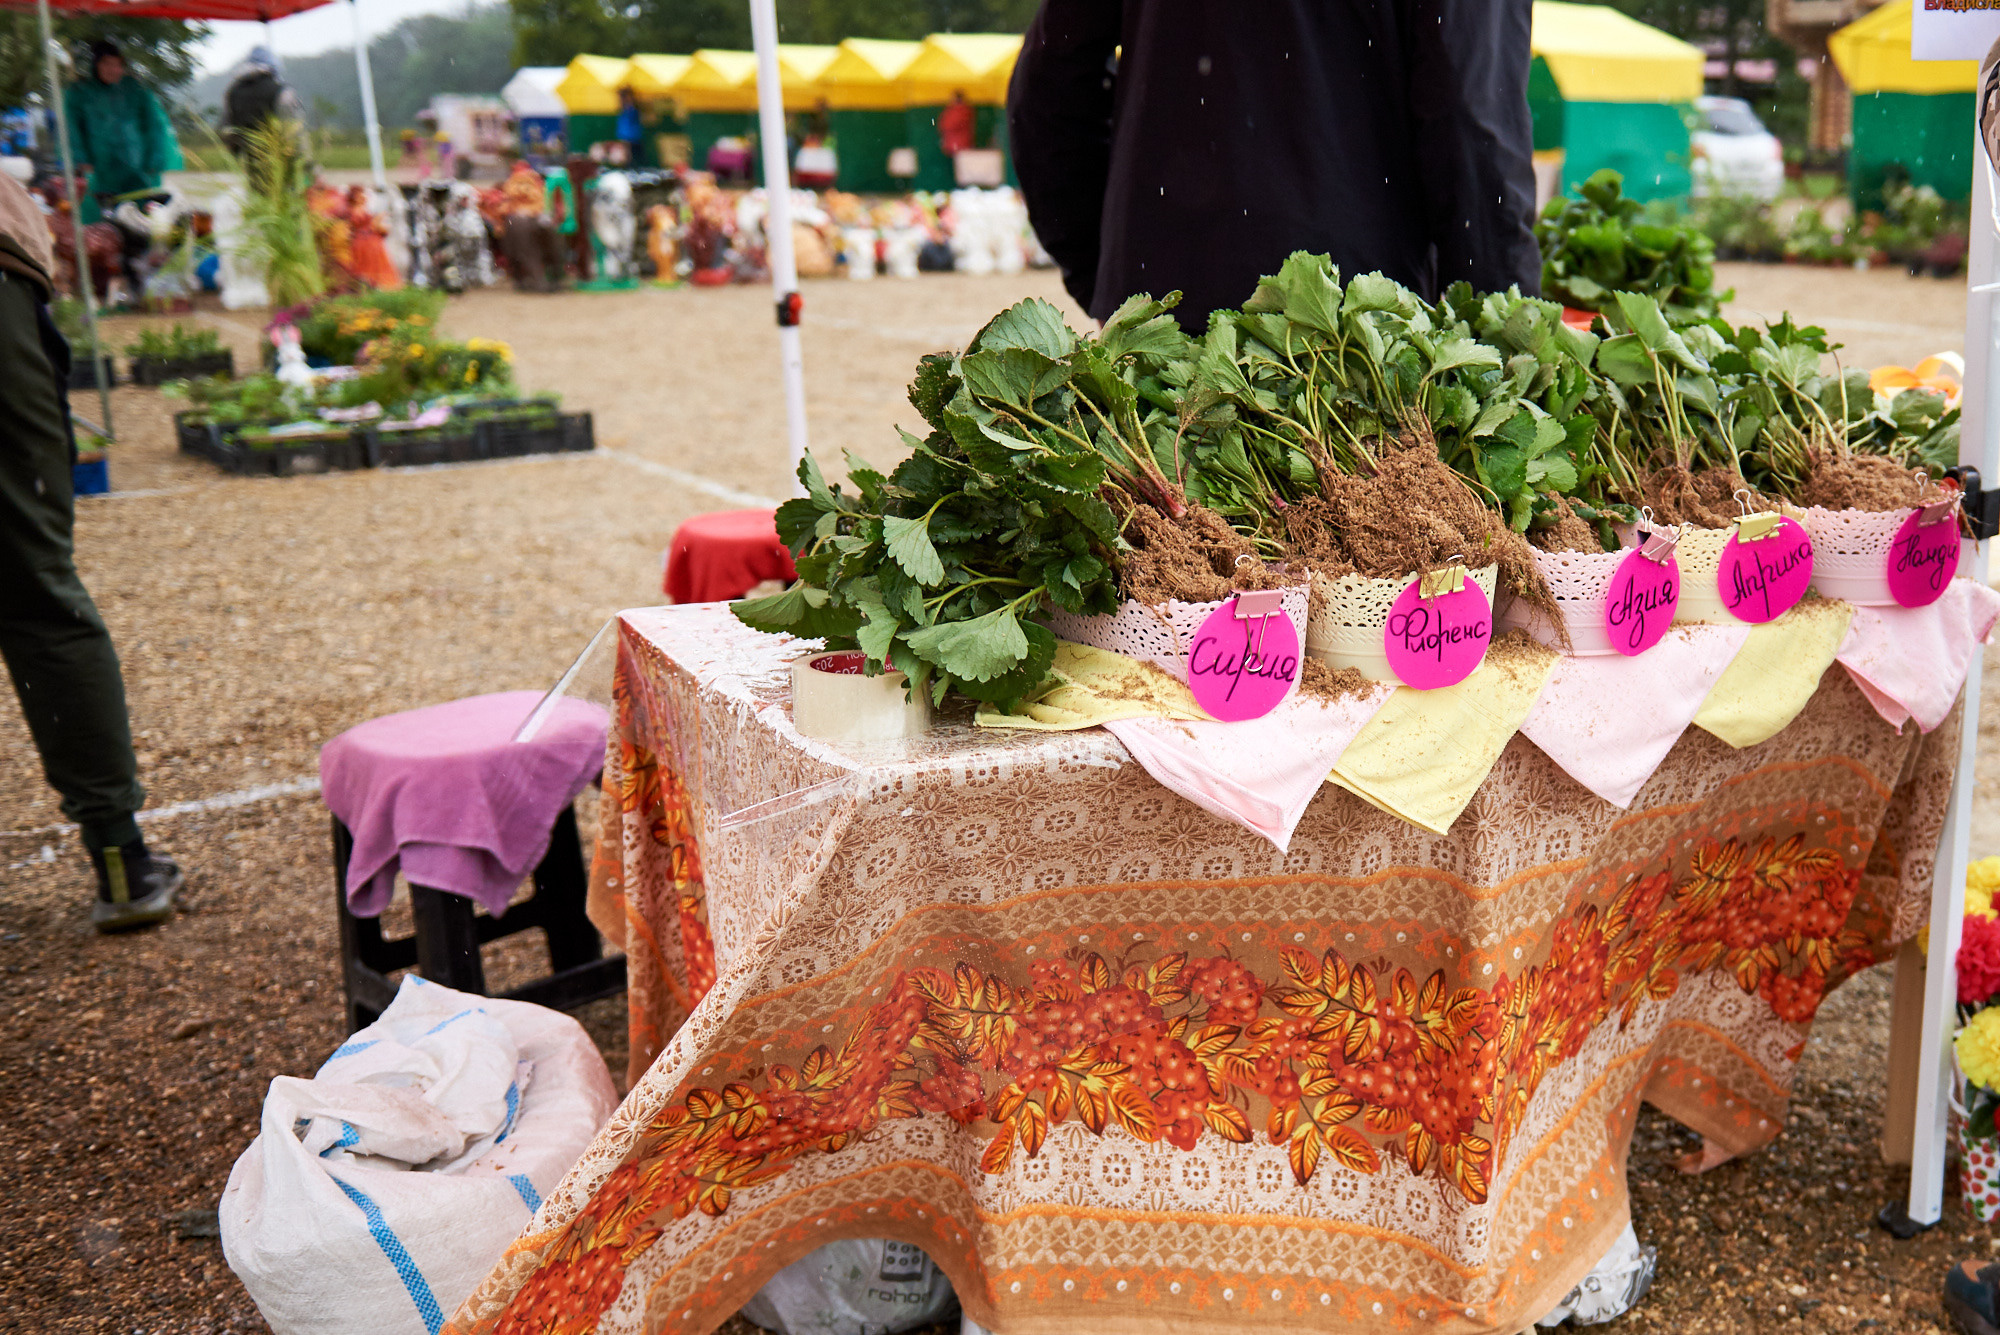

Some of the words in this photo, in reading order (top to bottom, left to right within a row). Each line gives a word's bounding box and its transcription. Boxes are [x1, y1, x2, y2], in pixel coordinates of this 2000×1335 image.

[1609, 574, 1676, 648] Азия
[1728, 542, 1813, 618] Априка
[1190, 629, 1296, 702] Сирия
